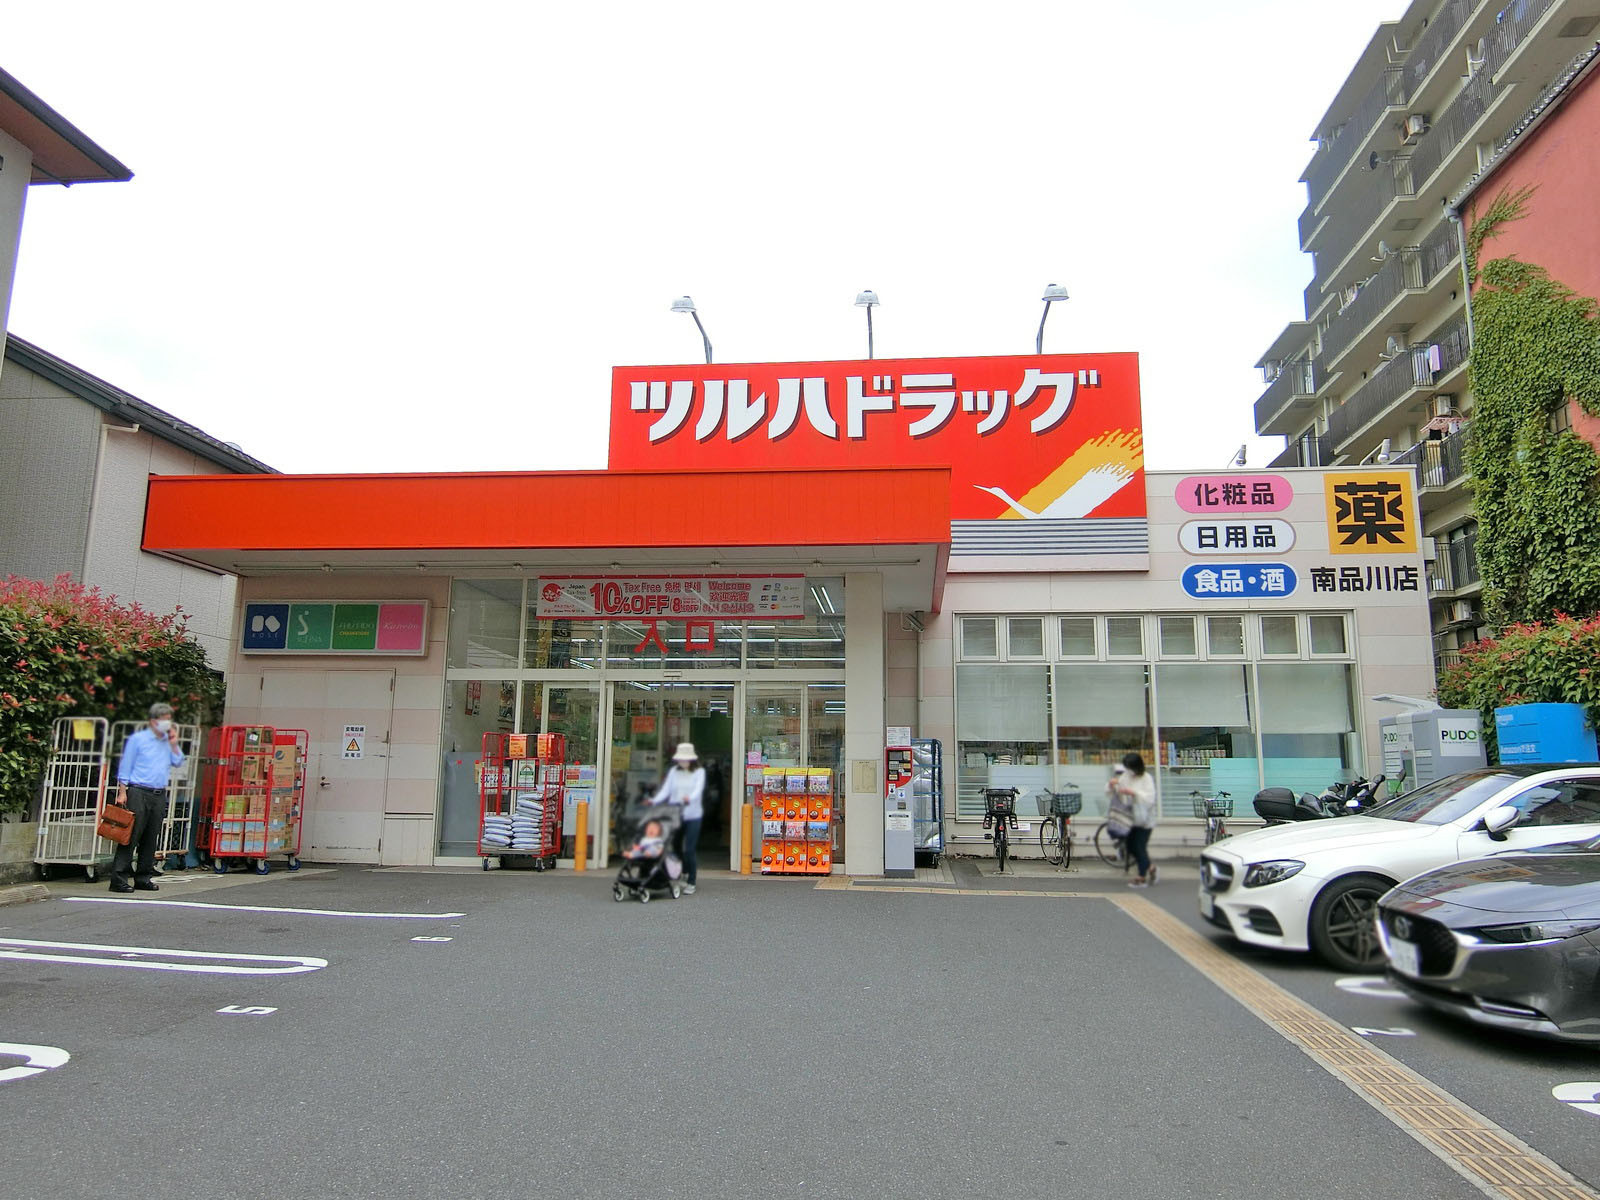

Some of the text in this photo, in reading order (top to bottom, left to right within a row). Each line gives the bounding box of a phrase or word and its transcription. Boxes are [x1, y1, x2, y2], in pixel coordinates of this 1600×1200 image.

[630, 369, 1102, 443] ツルハドラッグ
[1194, 482, 1275, 506] 化粧品
[1334, 481, 1405, 545] 薬
[1197, 525, 1276, 549] 日用品
[640, 583, 661, 593] Free
[708, 581, 752, 591] Welcome
[1194, 568, 1285, 593] 食品・酒
[1310, 566, 1418, 592] 南品川店
[633, 620, 715, 653] 入口
[1384, 732, 1398, 742] PUDO
[1441, 729, 1477, 741] PUDO
